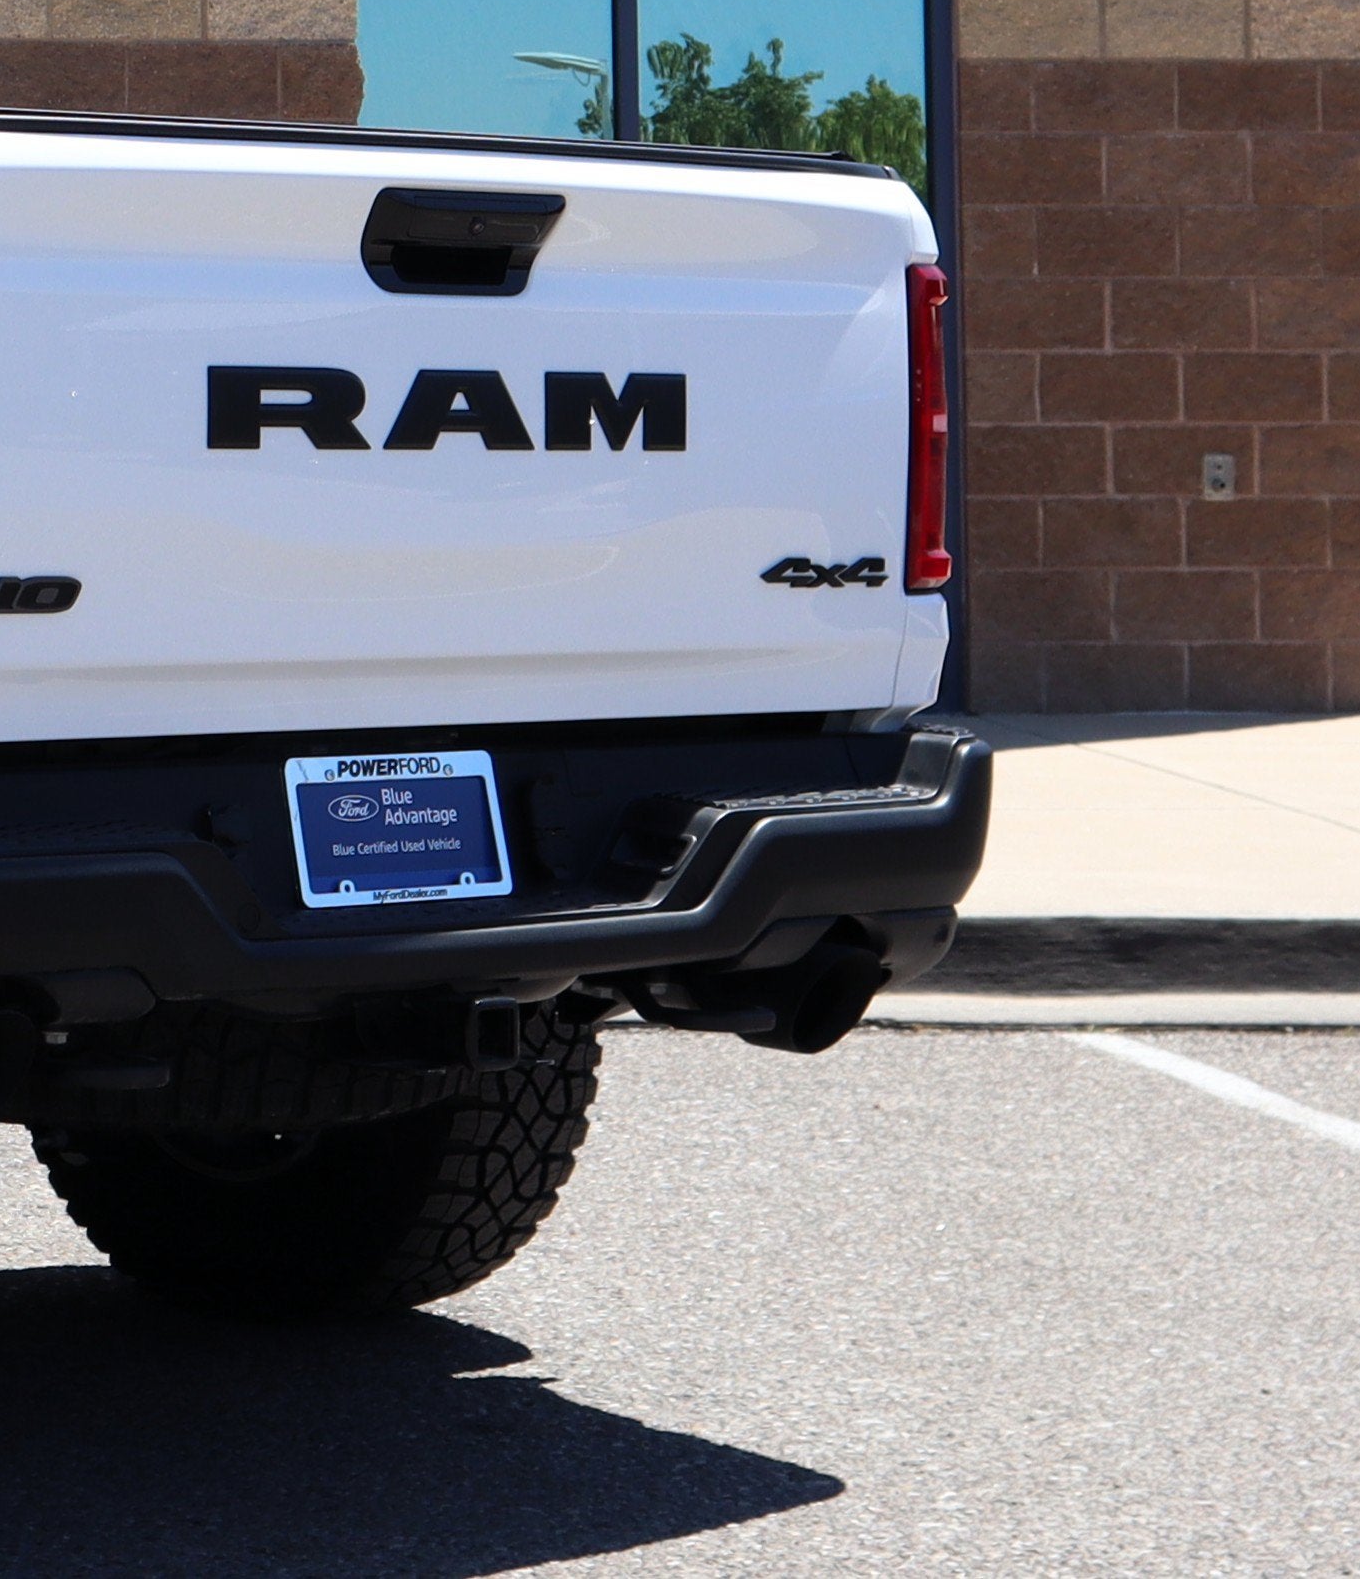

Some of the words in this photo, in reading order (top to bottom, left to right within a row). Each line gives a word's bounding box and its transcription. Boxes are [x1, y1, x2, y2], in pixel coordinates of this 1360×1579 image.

[206, 364, 687, 452] RAM
[760, 557, 890, 588] 4x4
[337, 757, 441, 778] POWERFORD
[381, 788, 413, 806] Blue
[338, 799, 370, 818] Ford
[385, 807, 458, 827] Advantage
[332, 843, 356, 856] Blue
[358, 839, 399, 855] Certified
[401, 838, 426, 853] Used
[428, 837, 461, 851] Vehicle
